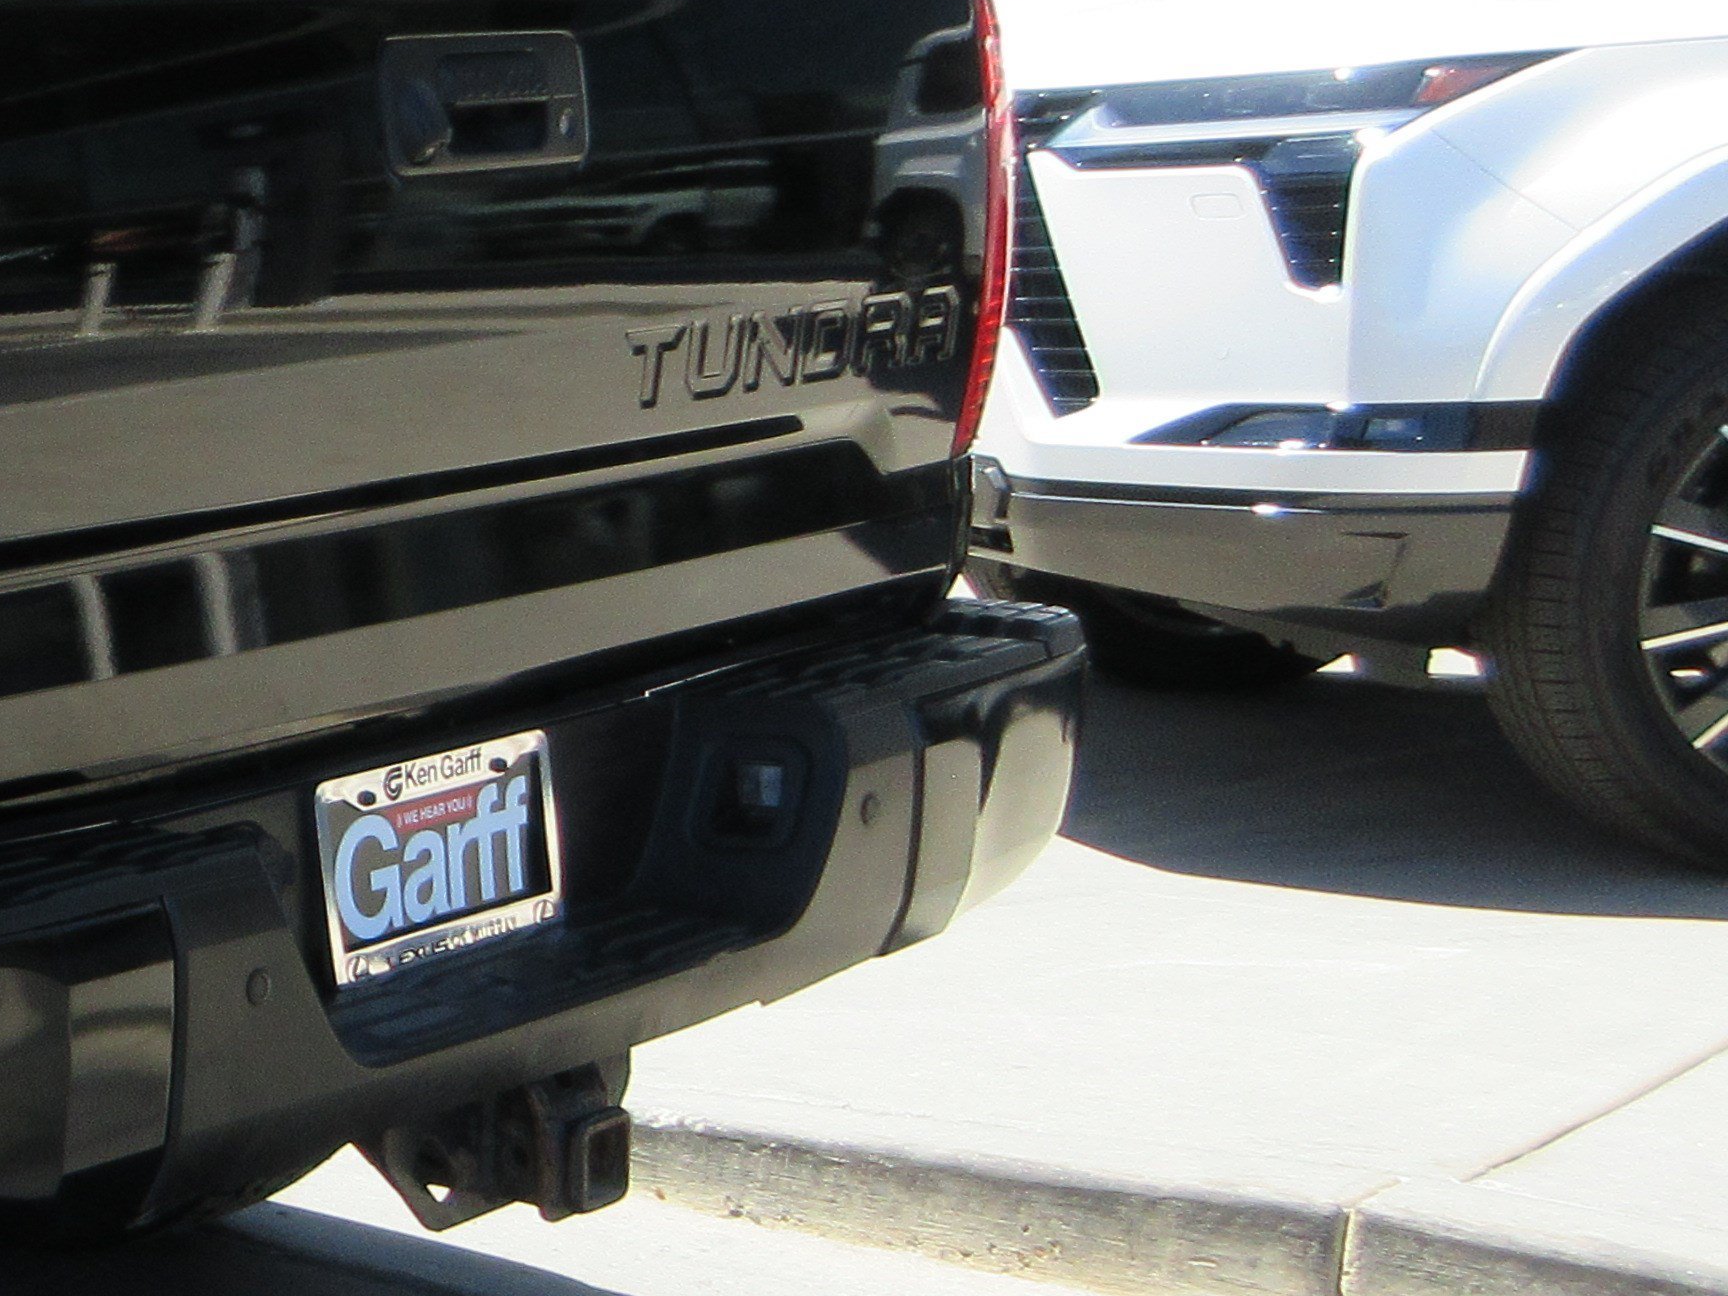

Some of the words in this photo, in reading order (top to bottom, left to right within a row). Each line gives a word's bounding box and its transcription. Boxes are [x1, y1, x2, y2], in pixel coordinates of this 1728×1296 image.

[625, 285, 960, 409] TUNDRA
[404, 762, 438, 789] Ken
[440, 747, 482, 779] Garff
[334, 774, 528, 940] Garff
